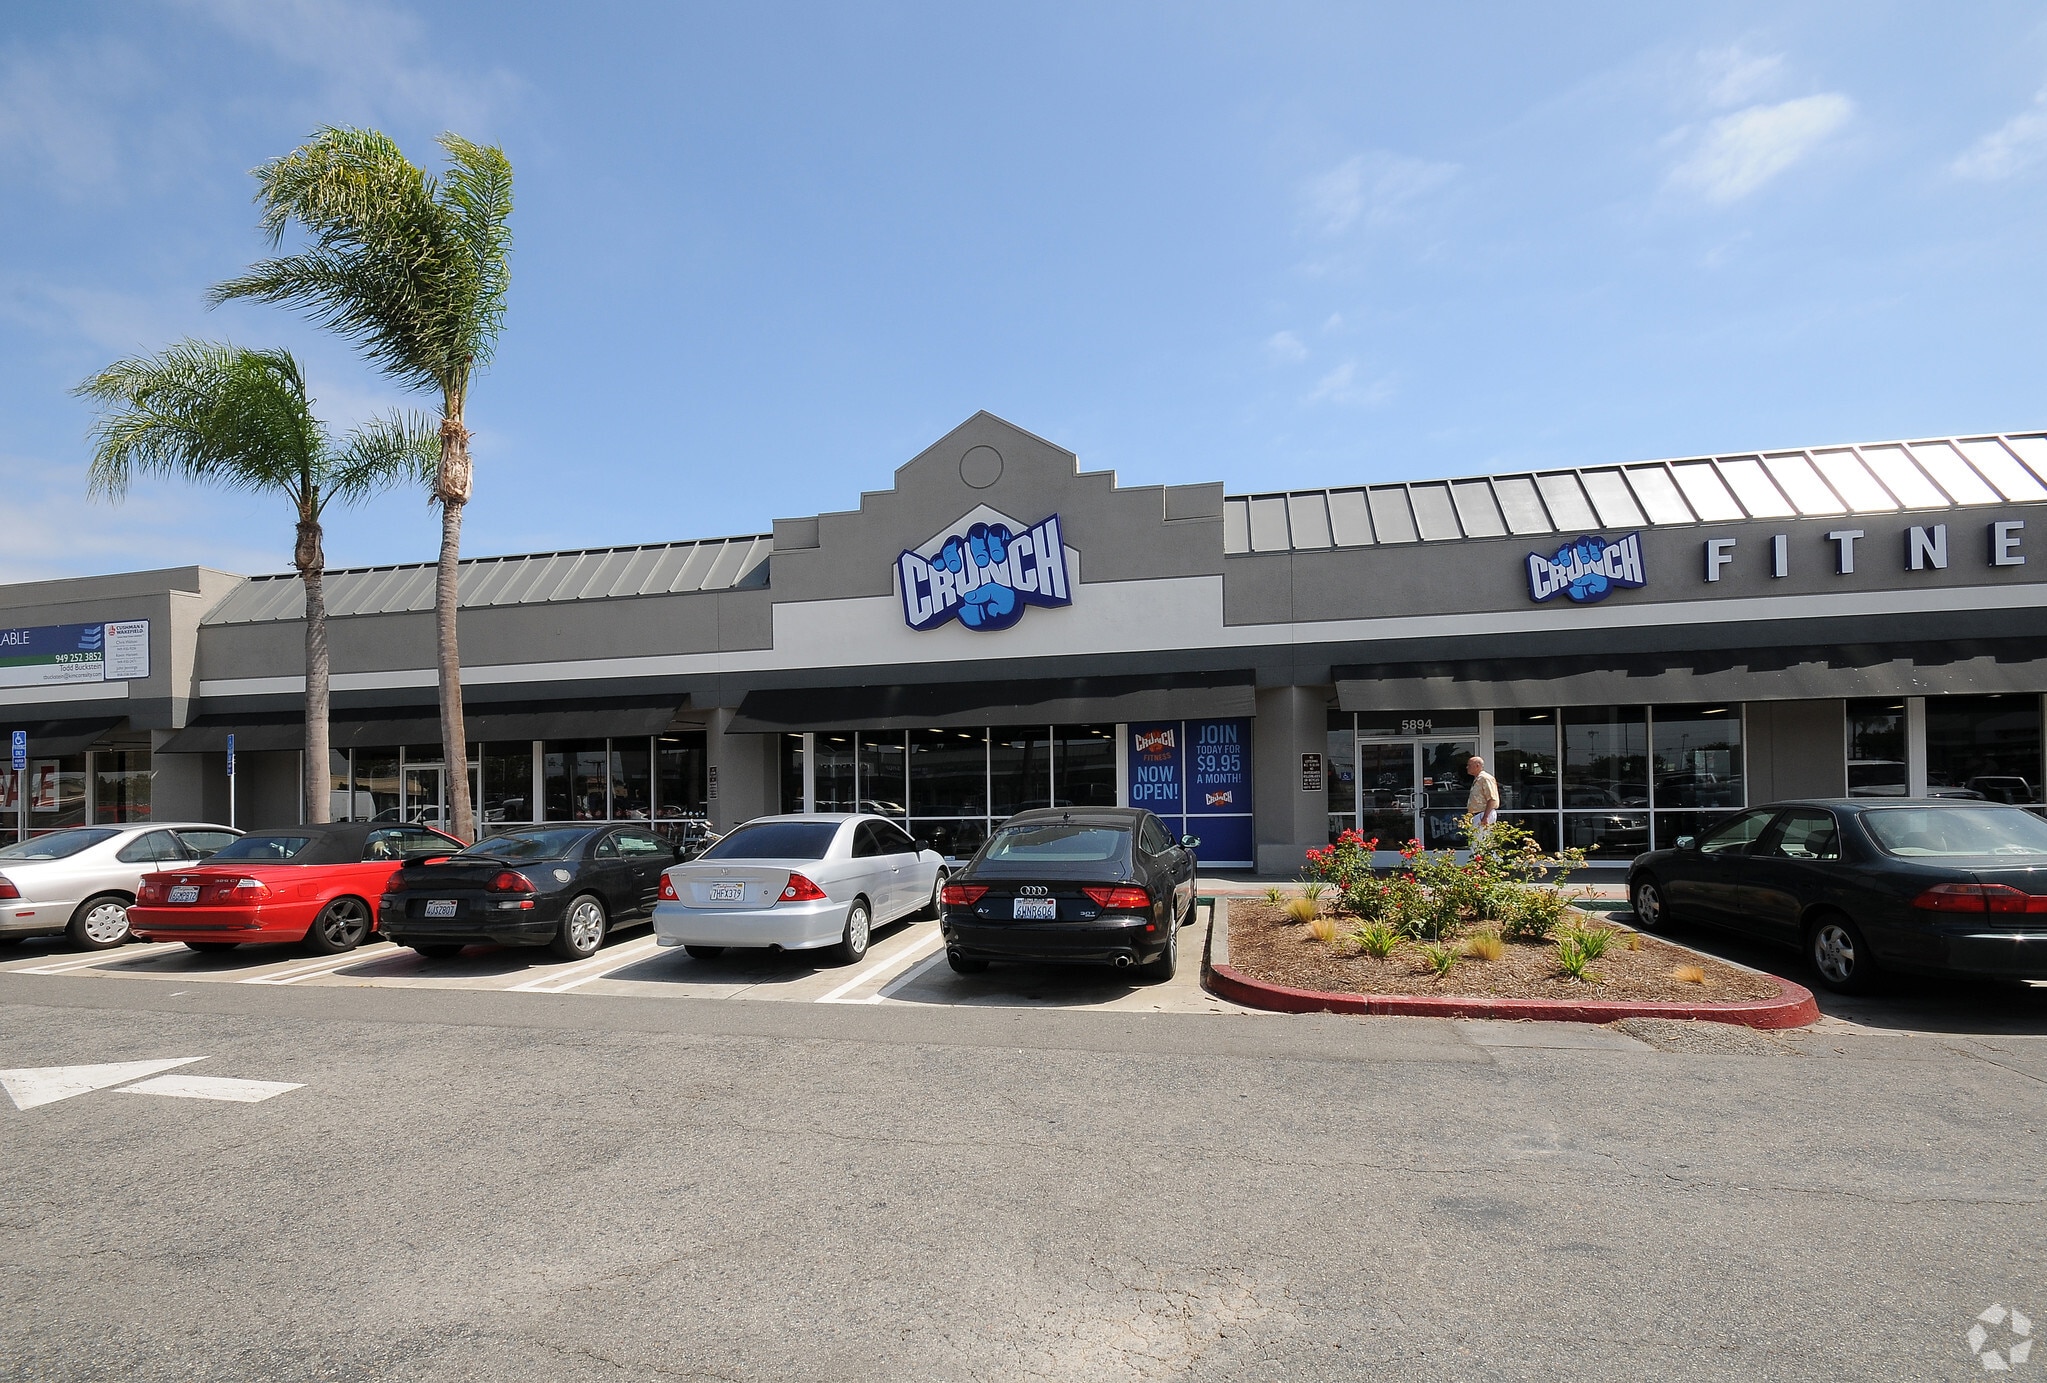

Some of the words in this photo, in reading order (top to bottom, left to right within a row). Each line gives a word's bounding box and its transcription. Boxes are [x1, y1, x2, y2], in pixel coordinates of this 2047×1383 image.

[902, 518, 1067, 626] CRUNCH
[1529, 533, 1642, 599] CRUNCH
[55, 653, 68, 663] 949
[70, 652, 83, 662] 252
[84, 651, 102, 662] 3852
[60, 663, 74, 672] Todd
[75, 662, 102, 671] Buckstein
[1401, 719, 1433, 730] 5894
[1135, 729, 1175, 752] CRUNCH
[1199, 724, 1237, 744] JOIN
[1143, 752, 1172, 761] FITNESS
[1196, 745, 1222, 755] TODAY
[1225, 744, 1241, 754] FOR
[1197, 754, 1241, 773] $9.95
[1137, 765, 1174, 783] NOW
[1196, 774, 1203, 784] A
[1205, 773, 1242, 784] MONTH!
[1133, 783, 1178, 800] OPEN!
[1205, 790, 1233, 806] CRUNCH
